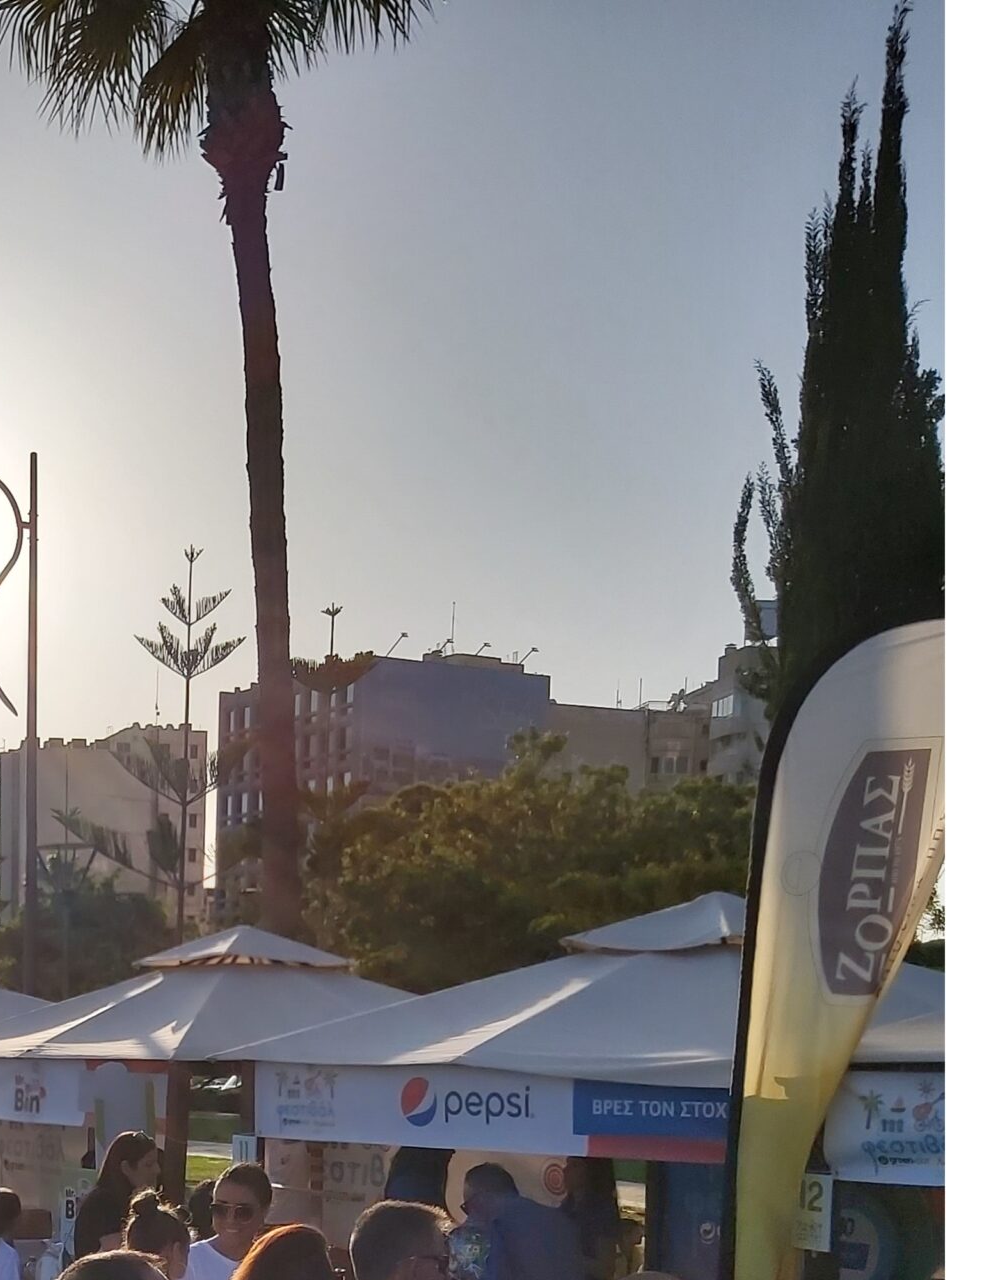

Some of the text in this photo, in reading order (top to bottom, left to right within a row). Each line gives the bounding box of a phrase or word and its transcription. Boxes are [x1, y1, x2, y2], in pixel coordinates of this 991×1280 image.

[835, 775, 901, 985] ΖΟΡΠΑΣ
[14, 1088, 40, 1114] Bin
[444, 1086, 530, 1125] pepsi
[592, 1099, 634, 1116] ΒΡΕΣ
[639, 1100, 675, 1117] ΤΟΝ
